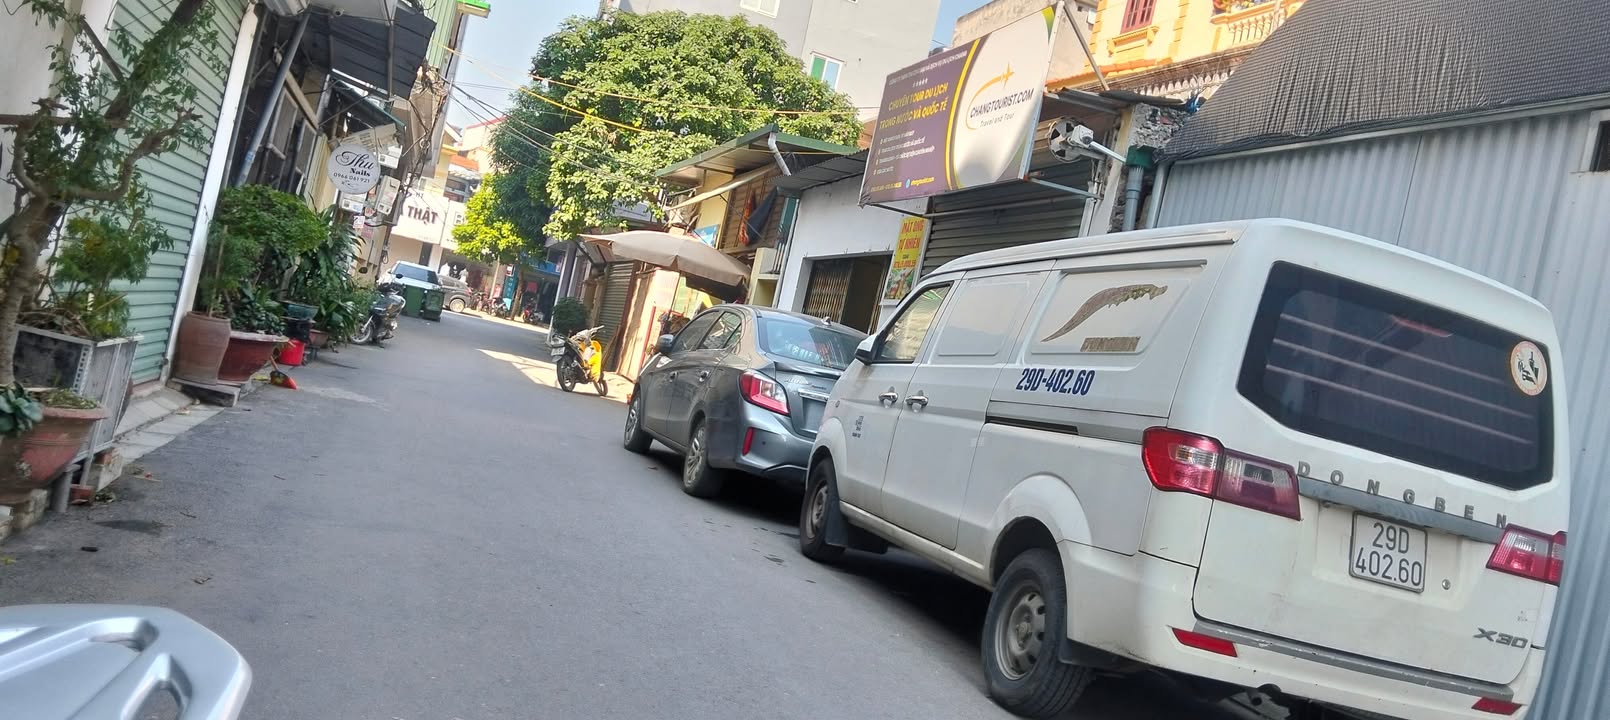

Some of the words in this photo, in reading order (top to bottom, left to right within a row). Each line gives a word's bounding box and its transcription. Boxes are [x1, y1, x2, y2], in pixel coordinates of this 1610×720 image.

[909, 90, 925, 104] TOUR
[924, 87, 933, 99] DU
[970, 87, 1035, 118] CHANGTOURIST.COM
[880, 116, 896, 129] TRONG
[912, 105, 922, 120] VÀ
[980, 117, 994, 127] Travel
[1003, 113, 1015, 121] Tour
[336, 151, 375, 170] Thu
[350, 168, 371, 177] Nails
[1016, 367, 1096, 396] 29D-402.60
[1297, 461, 1507, 529] DONGBEN
[1372, 522, 1410, 554] 29D
[1355, 547, 1423, 587] 402.60
[1472, 627, 1529, 650] X30
